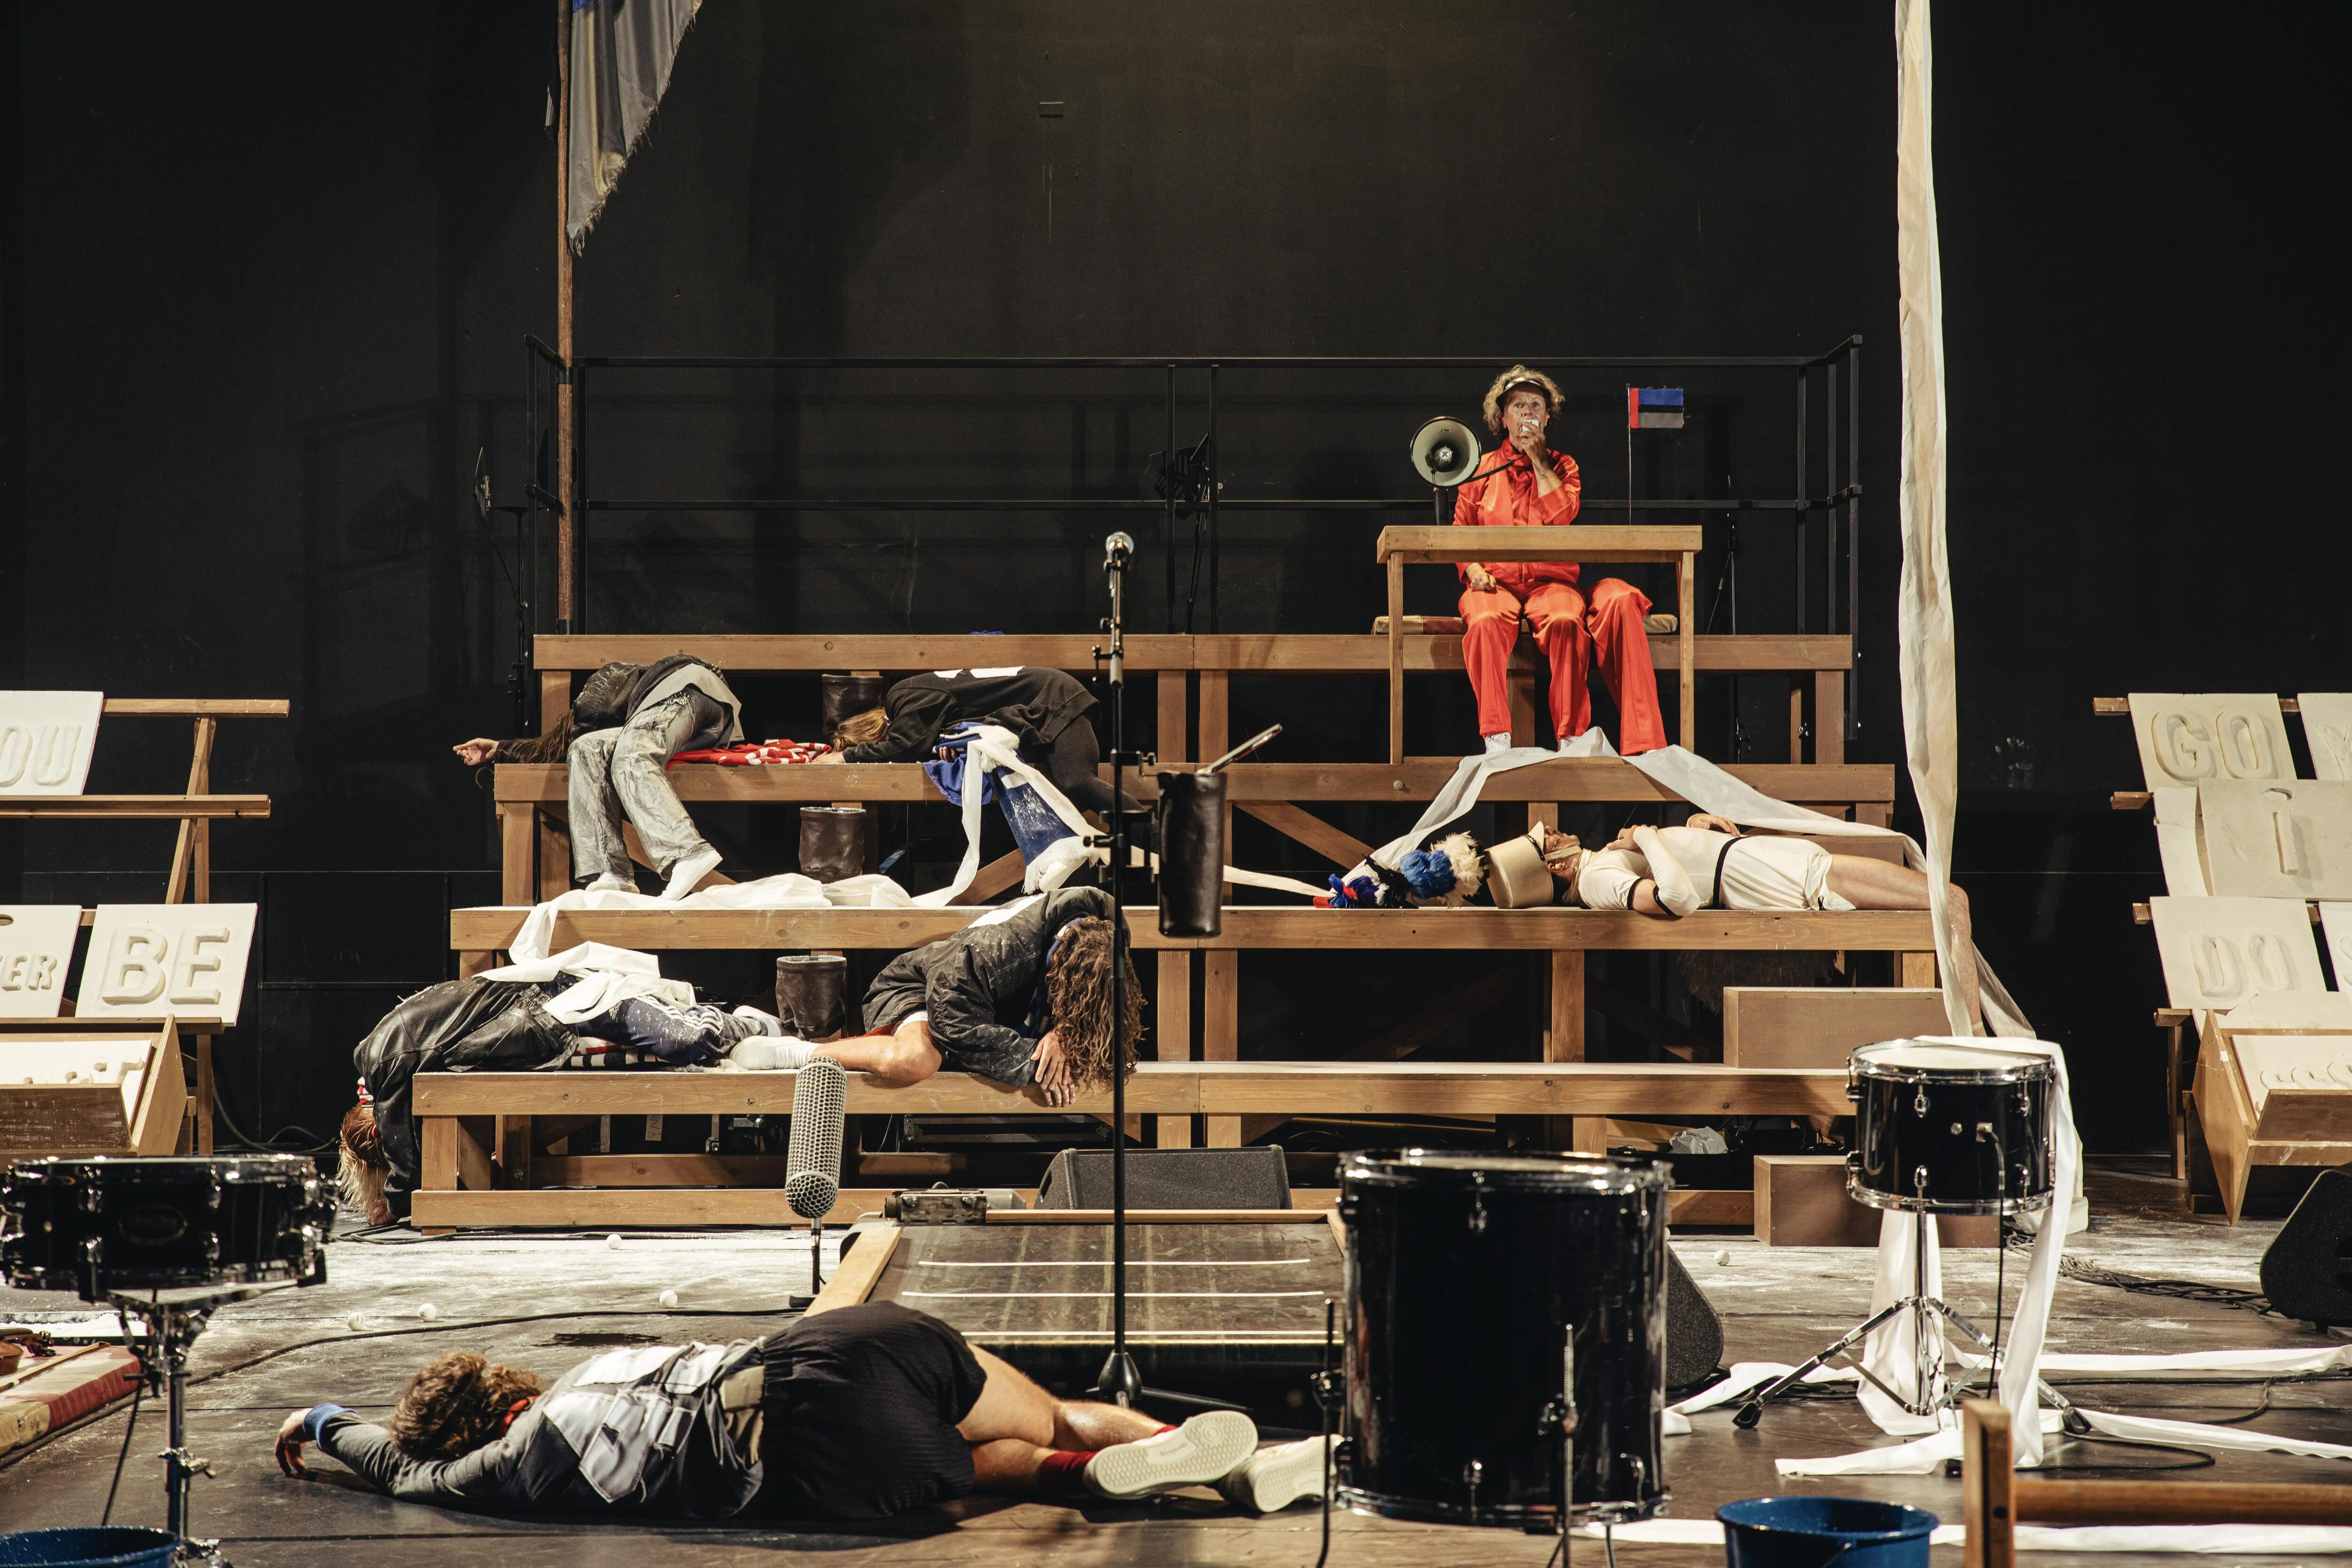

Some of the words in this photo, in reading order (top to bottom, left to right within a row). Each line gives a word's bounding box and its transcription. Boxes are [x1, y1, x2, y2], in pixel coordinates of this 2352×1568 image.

[2151, 707, 2274, 781] GO
[0, 954, 57, 991] ER
[98, 927, 230, 1006] BE
